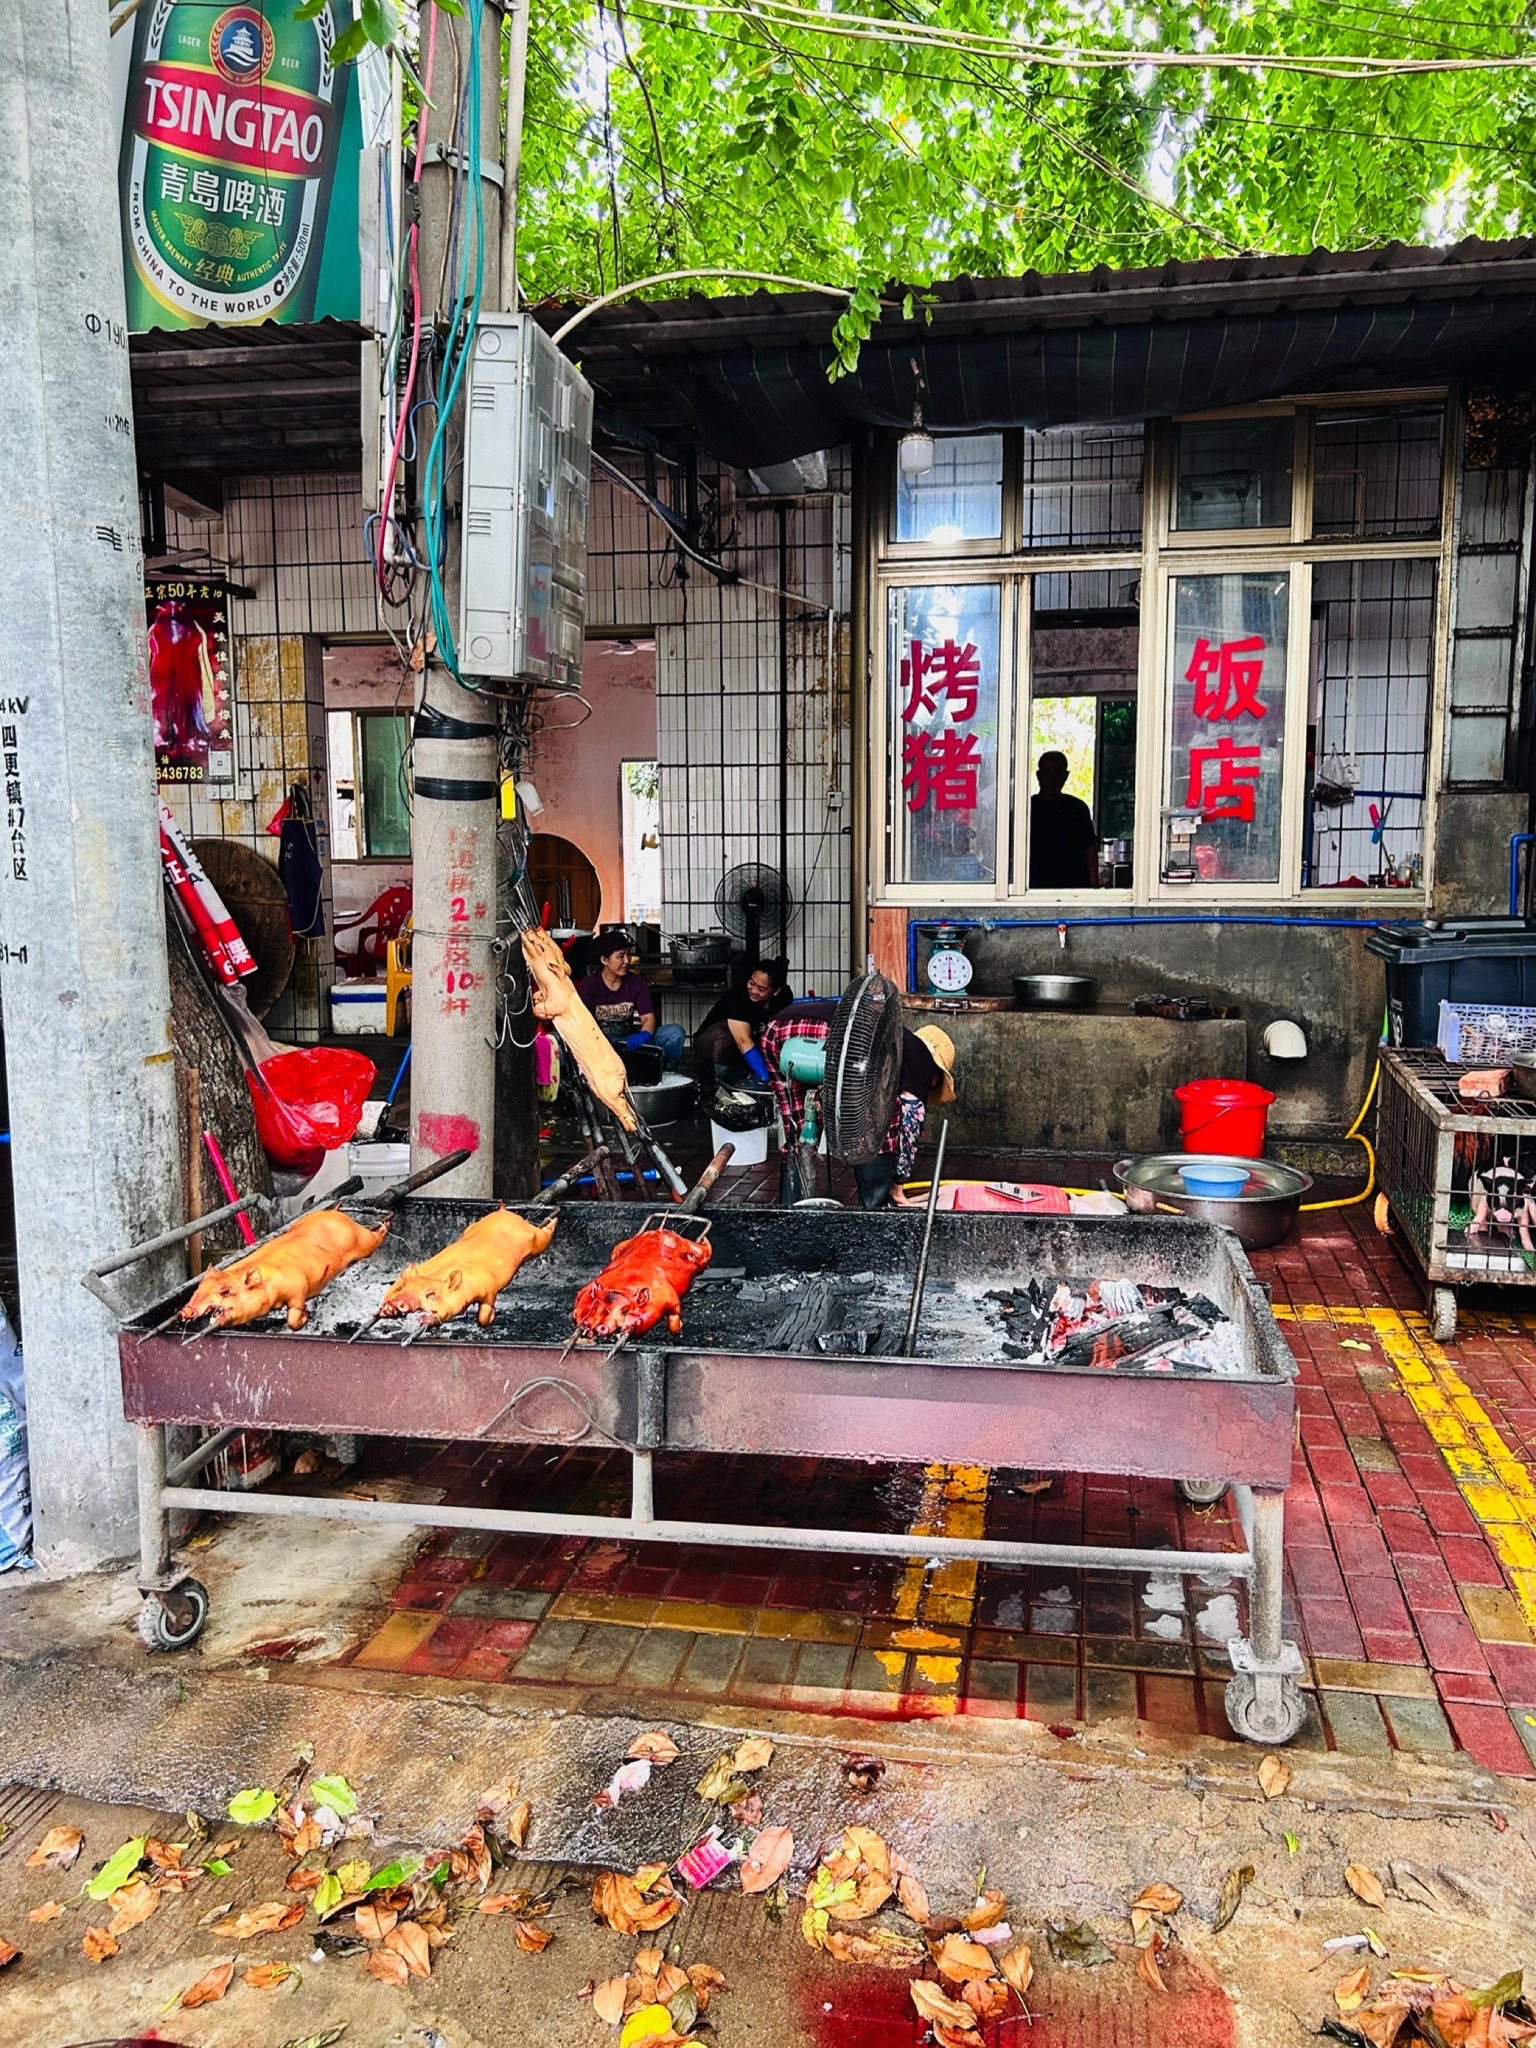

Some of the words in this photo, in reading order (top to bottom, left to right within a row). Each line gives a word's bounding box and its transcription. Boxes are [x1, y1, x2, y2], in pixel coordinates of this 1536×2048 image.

[178, 34, 202, 48] LAGER
[281, 56, 300, 70] BEER
[144, 77, 324, 163] TSINGTAO
[132, 181, 142, 230] FROM
[137, 235, 165, 280] CHINA
[168, 278, 185, 297] TO
[191, 293, 219, 312] THE
[224, 294, 271, 313] WORLD
[150, 209, 166, 242] MASTER
[164, 240, 194, 271] BREWERY
[193, 257, 236, 287] 经典
[236, 260, 273, 283] AUTHENTIC
[212, 611, 232, 740] 美味佳肴等你来
[899, 638, 982, 813] 烤猪
[1184, 635, 1269, 824] 饭店
